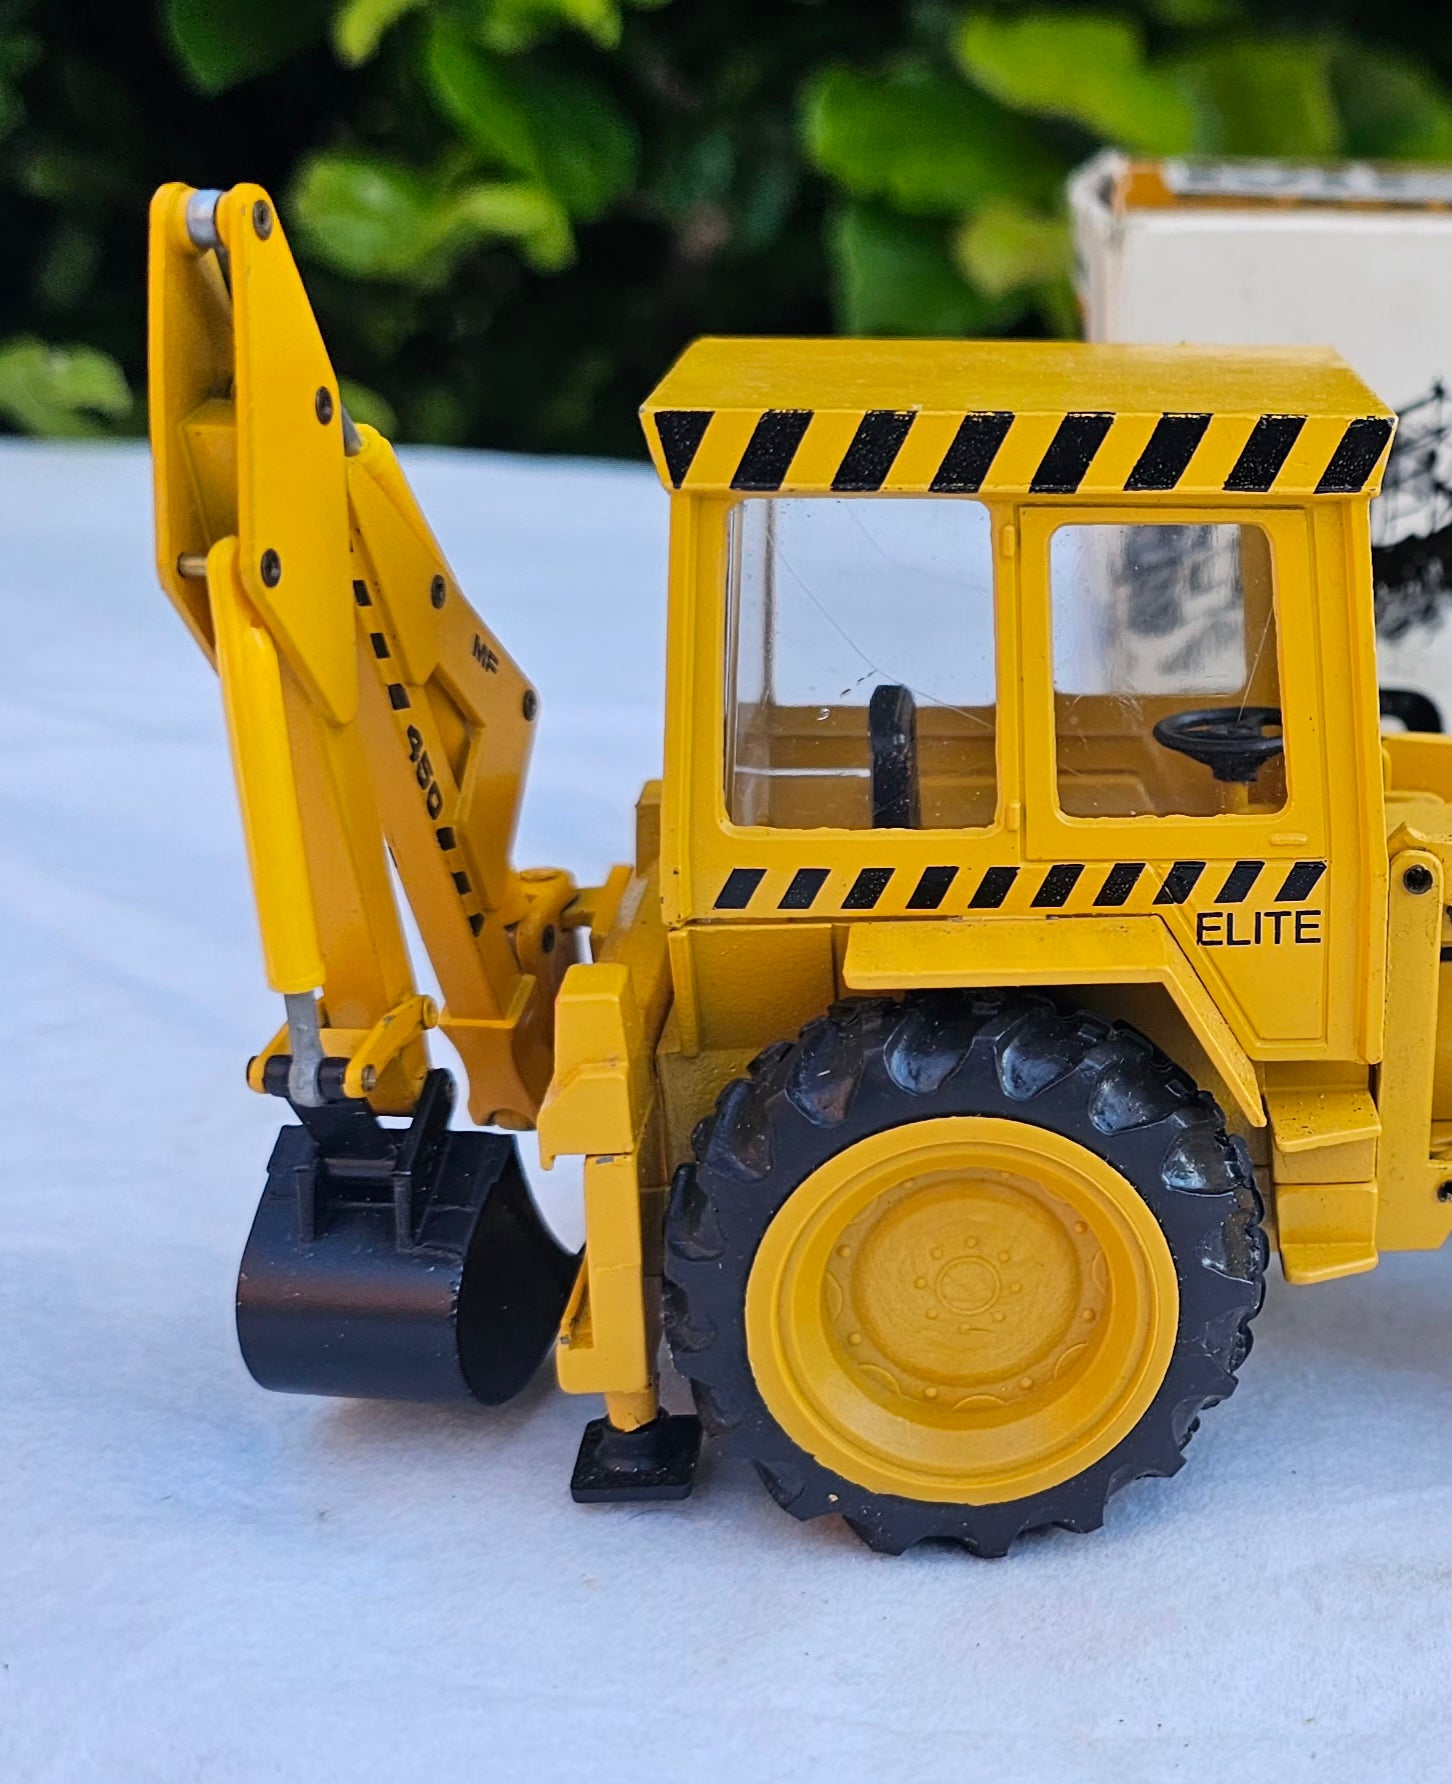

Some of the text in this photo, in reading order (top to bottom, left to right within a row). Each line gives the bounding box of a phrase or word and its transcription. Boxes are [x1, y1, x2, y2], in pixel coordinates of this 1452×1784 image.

[472, 632, 499, 674] MF
[407, 724, 443, 820] 450
[1196, 910, 1322, 946] ELITE
